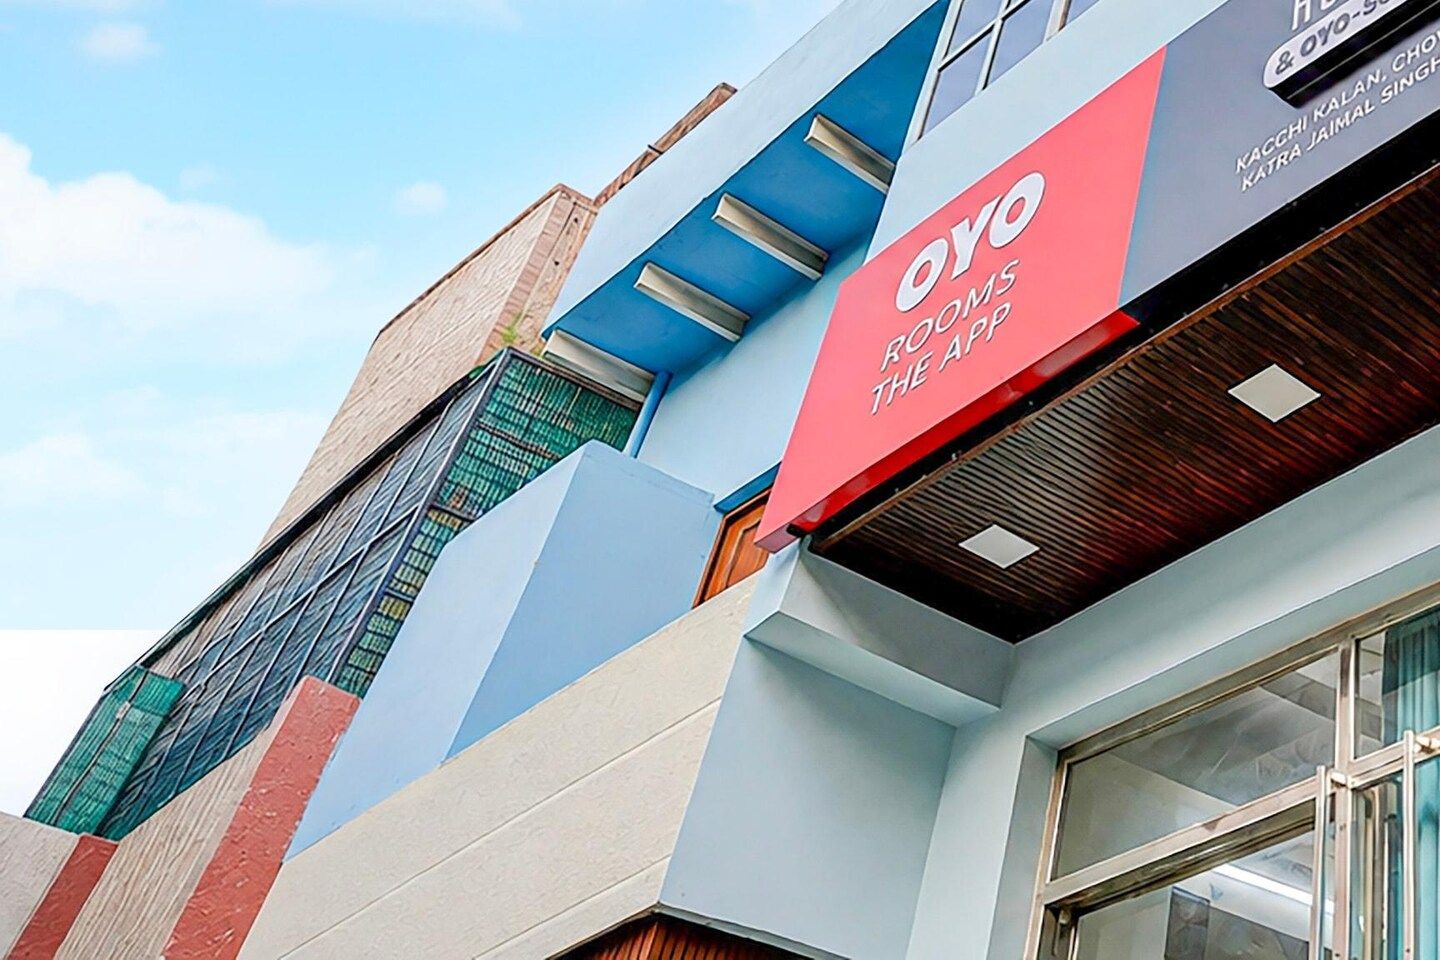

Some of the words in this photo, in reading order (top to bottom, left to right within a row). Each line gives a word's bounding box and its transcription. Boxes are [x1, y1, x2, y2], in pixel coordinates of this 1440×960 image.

[1275, 50, 1295, 75] &
[1236, 115, 1308, 174] KACCHI
[1242, 143, 1302, 192] KATRA
[1306, 98, 1376, 152] JAIMAL
[895, 171, 1046, 313] OYO
[871, 350, 934, 416] THE
[938, 302, 1011, 372] APP
[880, 258, 1020, 373] ROOMS
